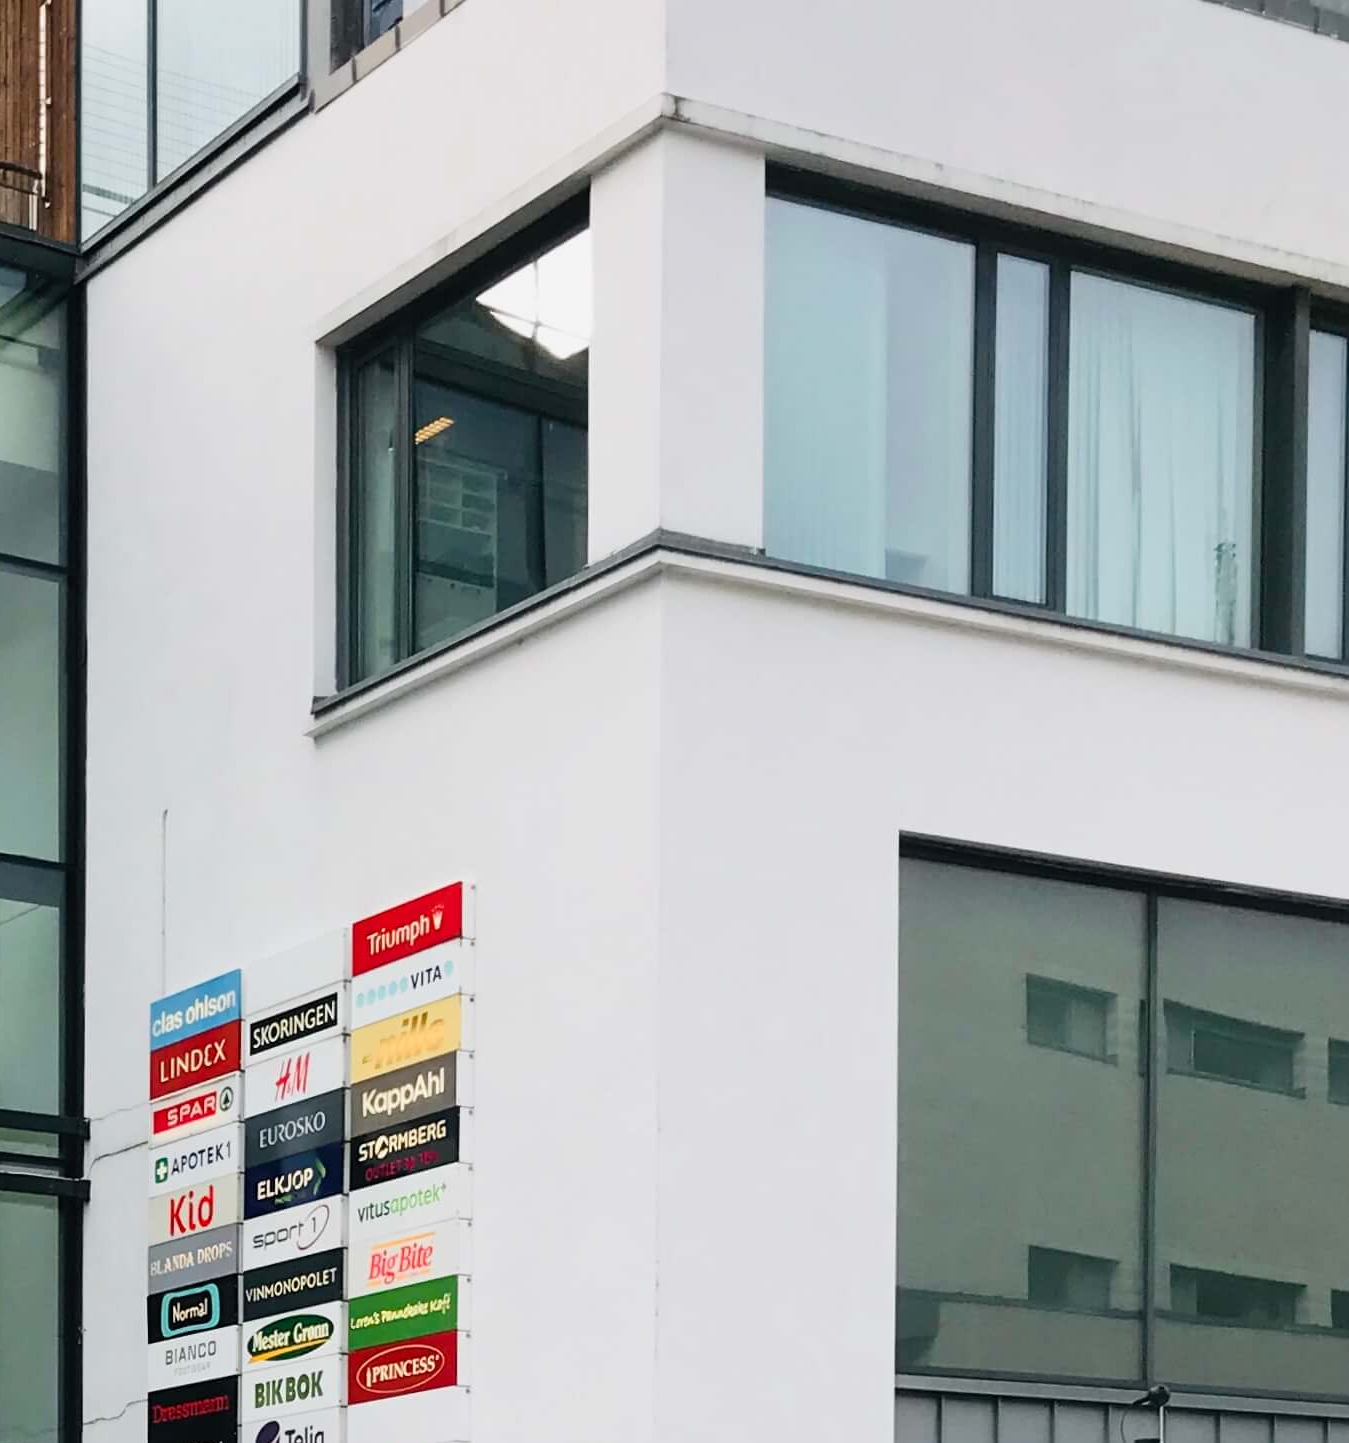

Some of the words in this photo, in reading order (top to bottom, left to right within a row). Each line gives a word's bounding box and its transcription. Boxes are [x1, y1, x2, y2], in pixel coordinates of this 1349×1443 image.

[367, 915, 430, 955] Triumph
[410, 965, 442, 989] VITA
[152, 1013, 183, 1037] clas
[185, 990, 236, 1026] ohlson
[252, 1001, 336, 1049] SKORINGEN
[160, 1039, 226, 1083] LINDEX
[167, 1093, 216, 1127] SPAR
[362, 1071, 445, 1116] KappAhl
[260, 1112, 326, 1148] EUROSKO
[171, 1144, 223, 1175] APOTEK
[169, 1185, 214, 1237] Kid
[197, 1241, 233, 1263] DROPS
[369, 1244, 397, 1284] Big
[399, 1242, 433, 1274] Bite
[246, 1268, 337, 1302] VINMONOPOLET
[172, 1299, 208, 1323] Normal
[165, 1340, 216, 1365] BIANCO
[252, 1325, 290, 1351] Mester
[255, 1379, 283, 1409] BIK
[286, 1370, 323, 1403] BOK
